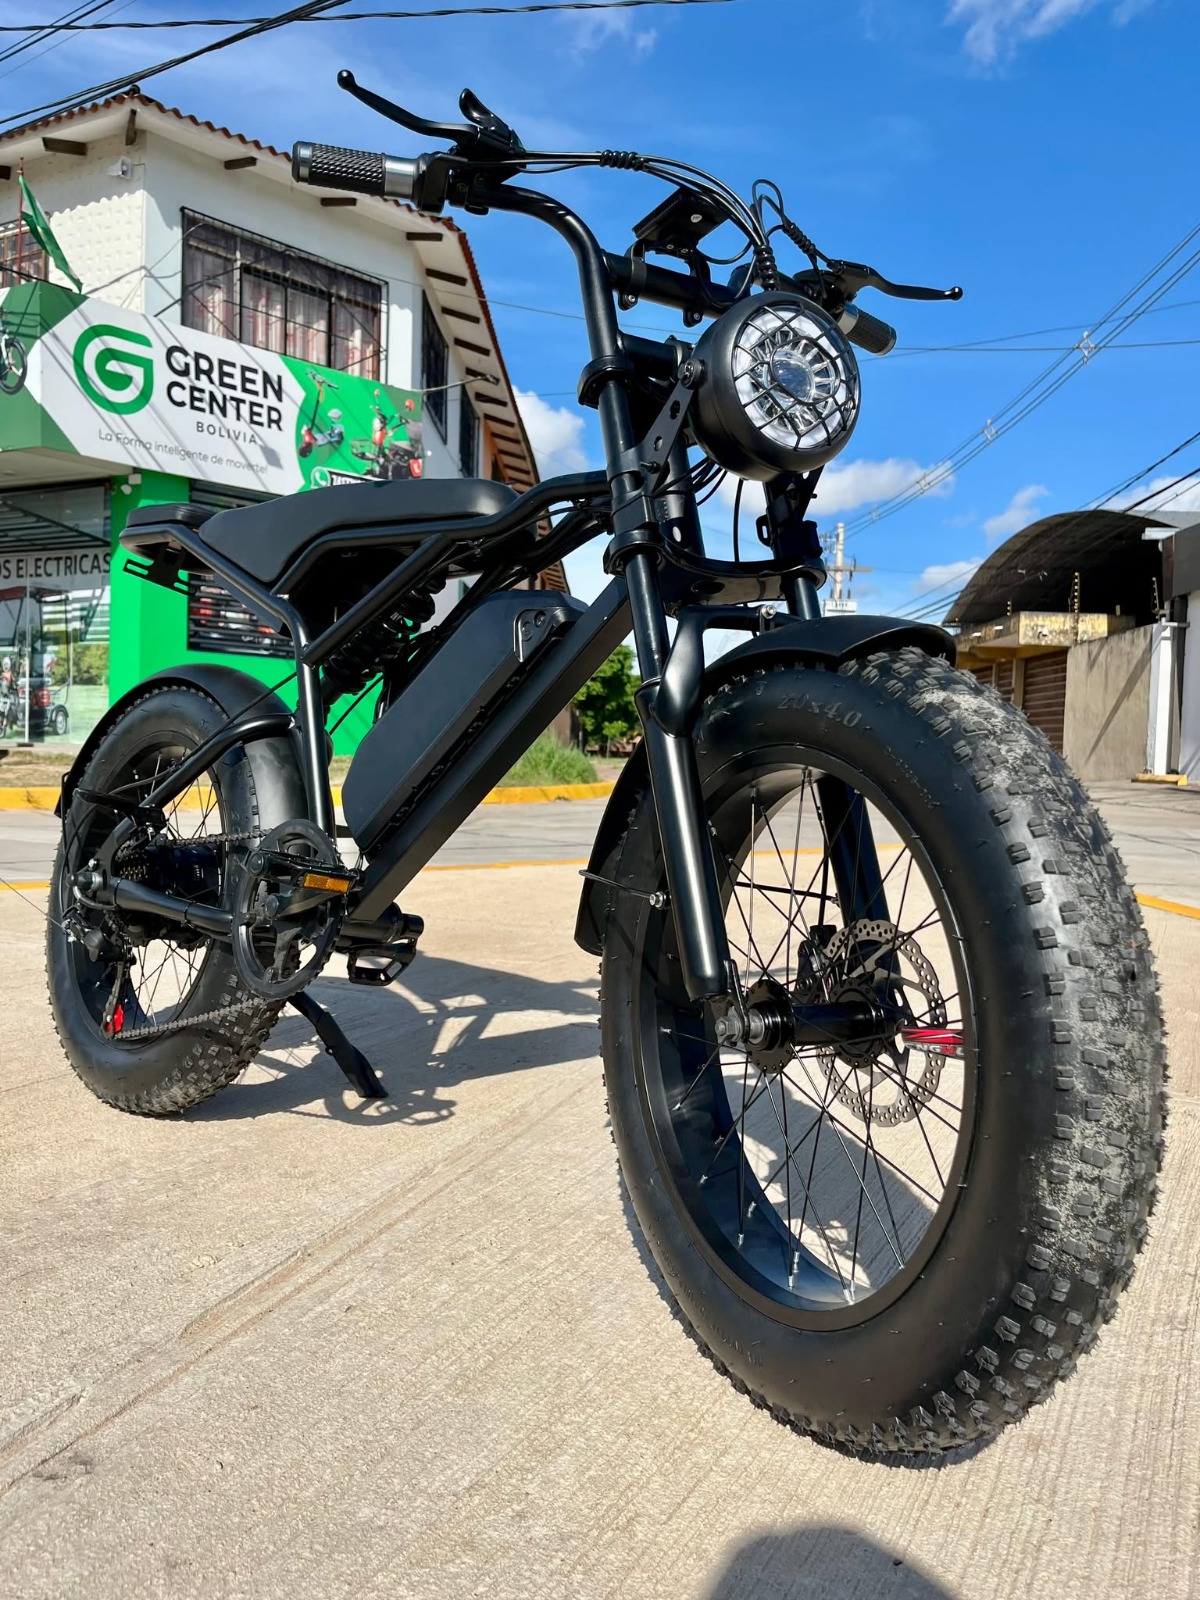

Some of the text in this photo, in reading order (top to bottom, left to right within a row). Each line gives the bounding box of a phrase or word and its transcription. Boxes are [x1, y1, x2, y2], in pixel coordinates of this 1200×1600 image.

[165, 345, 284, 403] GREEN
[166, 381, 284, 432] CENTER
[98, 428, 113, 443] La
[115, 431, 153, 451] Forma
[154, 441, 210, 463] inteligente
[210, 454, 224, 466] de
[195, 421, 258, 445] BOLIVIA
[16, 551, 111, 578] ELECTRICAS
